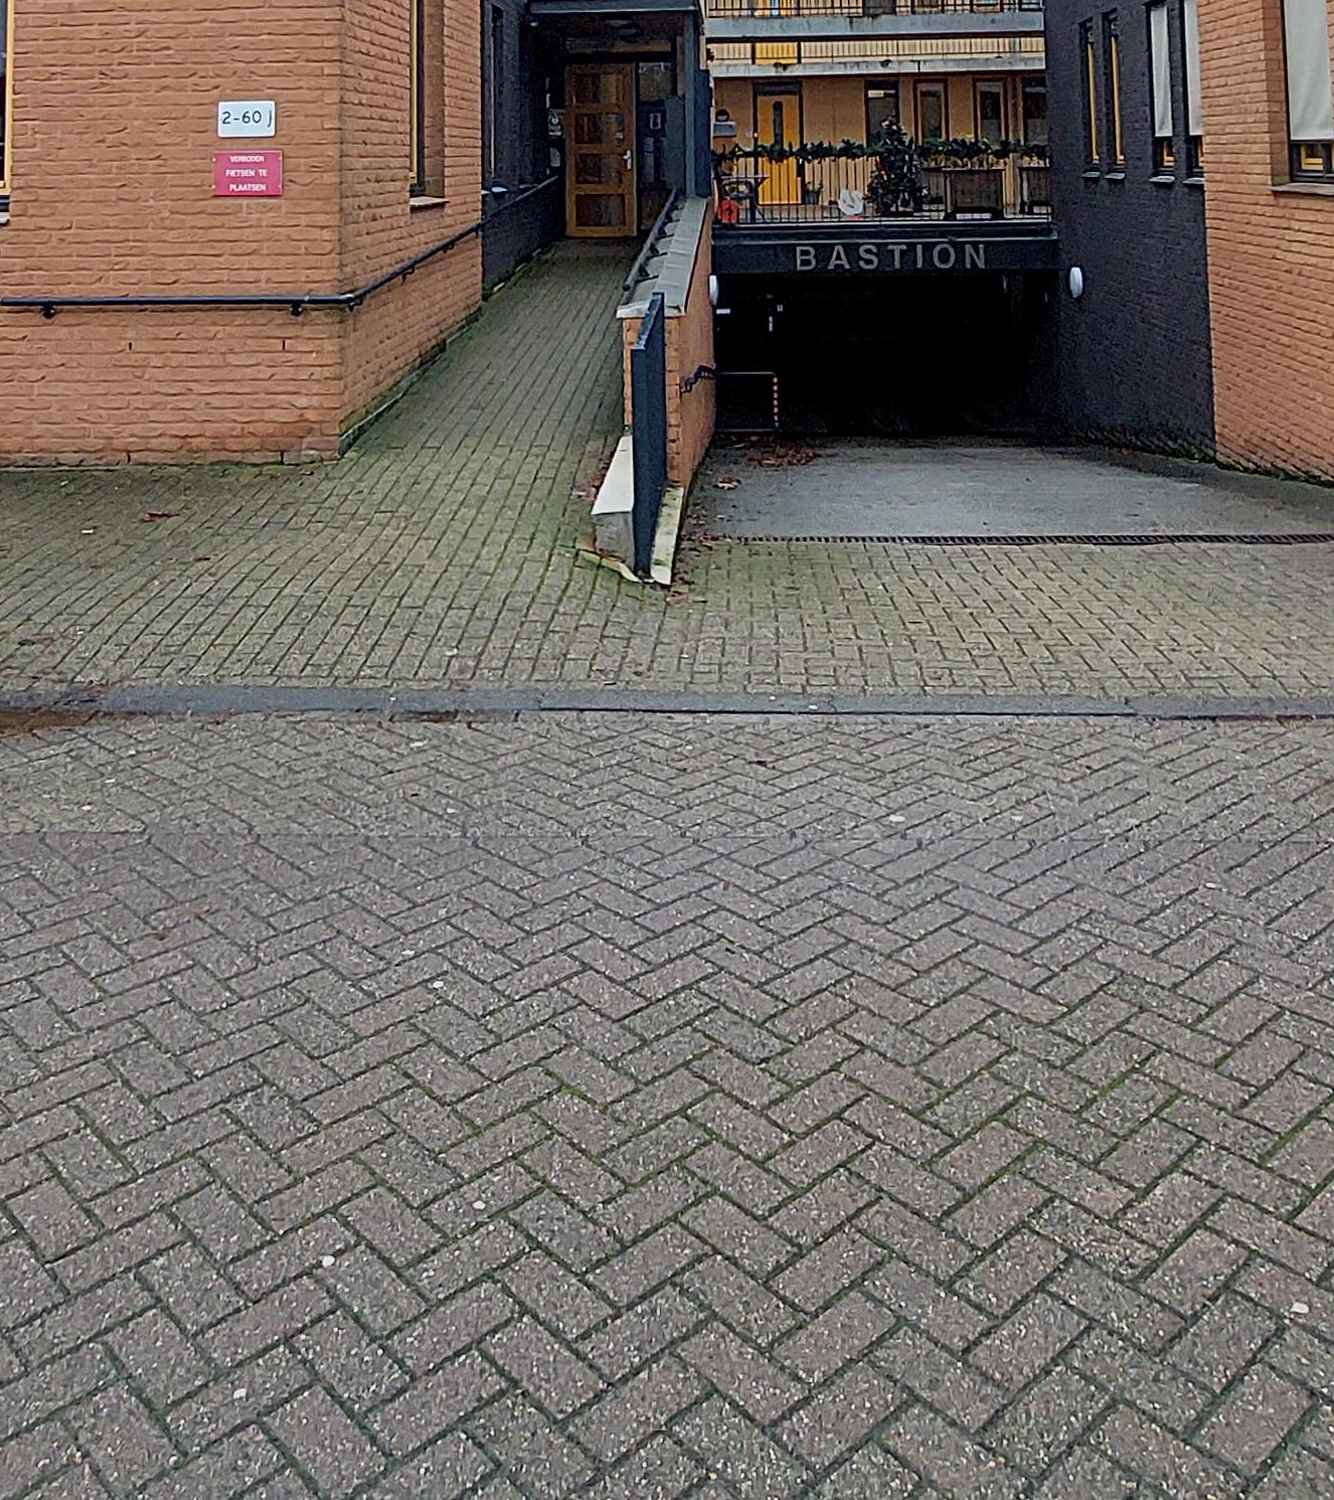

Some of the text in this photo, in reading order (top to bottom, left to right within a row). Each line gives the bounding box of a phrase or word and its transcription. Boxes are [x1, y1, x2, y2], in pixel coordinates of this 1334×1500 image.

[222, 110, 262, 124] 2-60
[229, 155, 265, 163] VERBODEN
[225, 169, 268, 177] FIETSEN TE
[229, 184, 267, 192] PLAATSEN
[796, 243, 986, 271] BASTION
